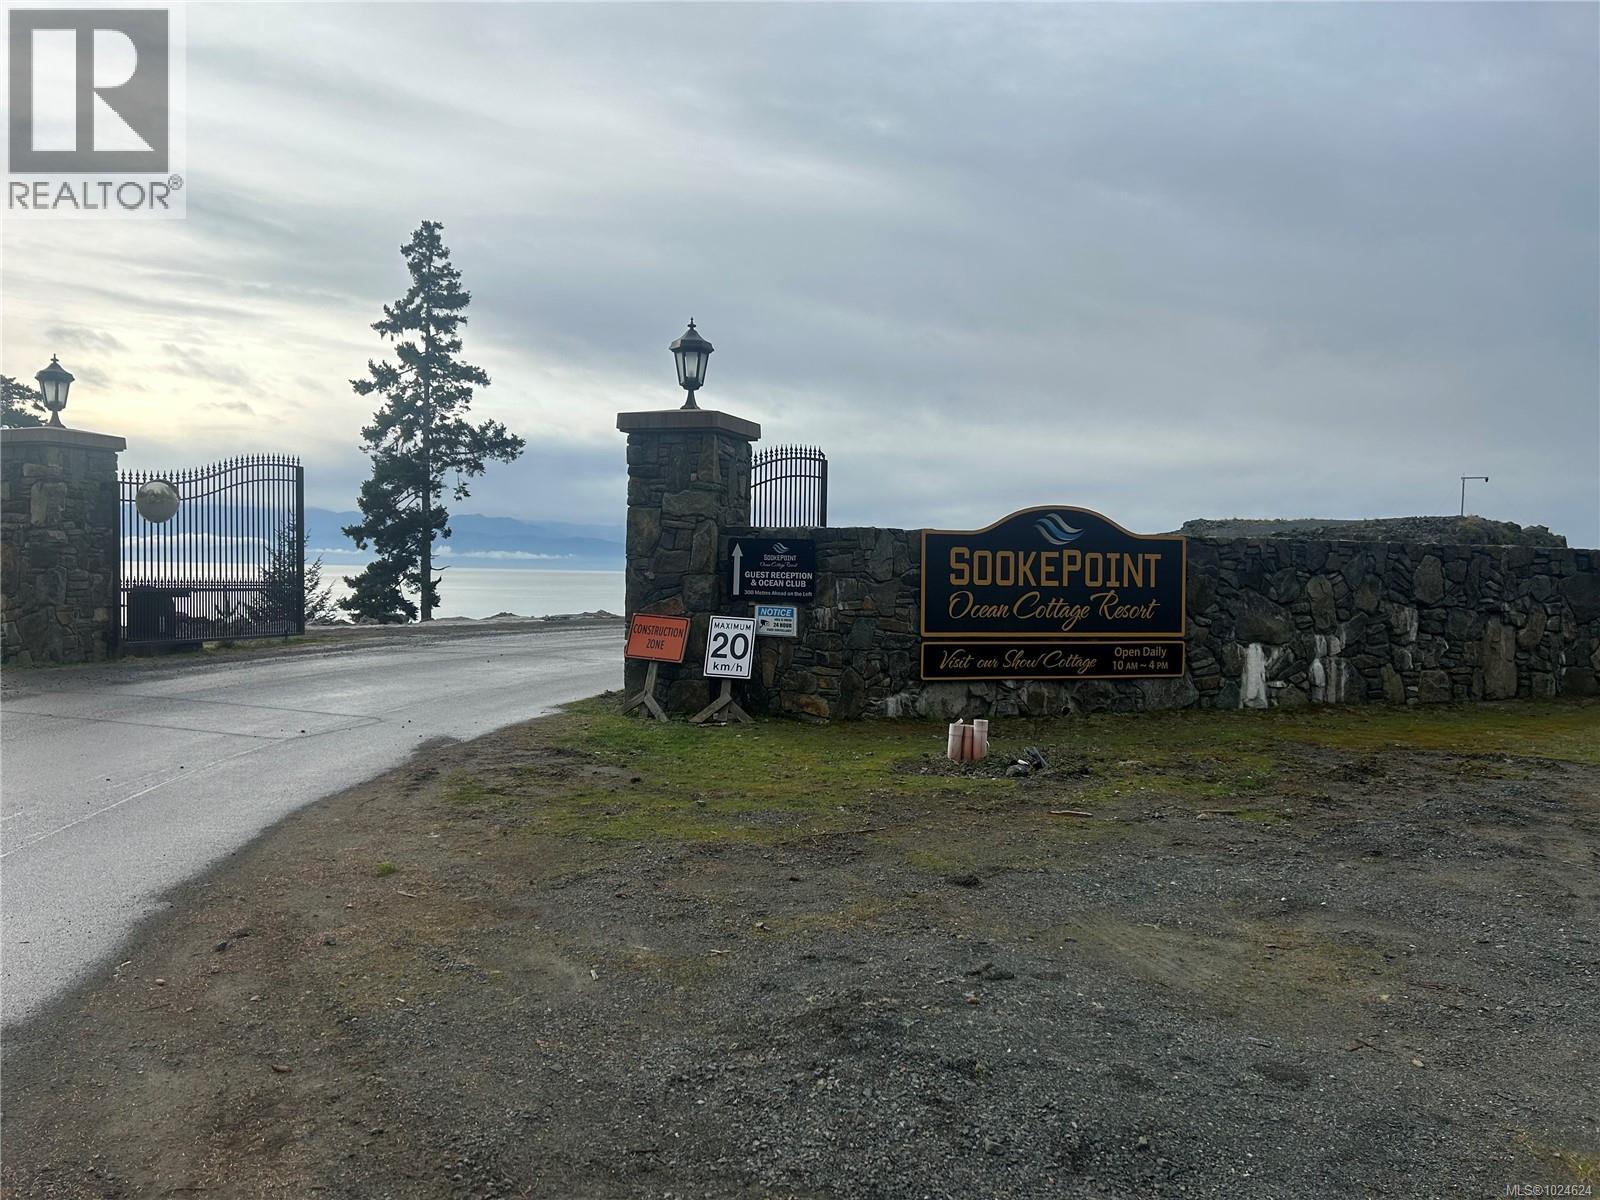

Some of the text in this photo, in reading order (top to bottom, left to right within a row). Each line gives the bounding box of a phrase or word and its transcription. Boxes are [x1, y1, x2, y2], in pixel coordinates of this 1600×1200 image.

[770, 571, 813, 580] RECEPTION
[758, 579, 784, 587] OCEAN
[785, 580, 807, 588] CLUB
[760, 607, 791, 617] NOTICE
[949, 589, 1160, 632] Ocean Cottage Resort
[633, 623, 685, 639] CONSTRUCTION
[713, 622, 751, 631] MAXIMUM
[646, 638, 665, 650] ZONE
[710, 632, 749, 660] 20
[1114, 646, 1167, 660] Open Daily
[713, 661, 743, 672] km/h
[939, 649, 1097, 674] Visit our Show Cottage
[1112, 660, 1124, 671] 10
[1125, 661, 1139, 670] AM
[1148, 660, 1155, 670] 4
[1156, 661, 1169, 670] PM
